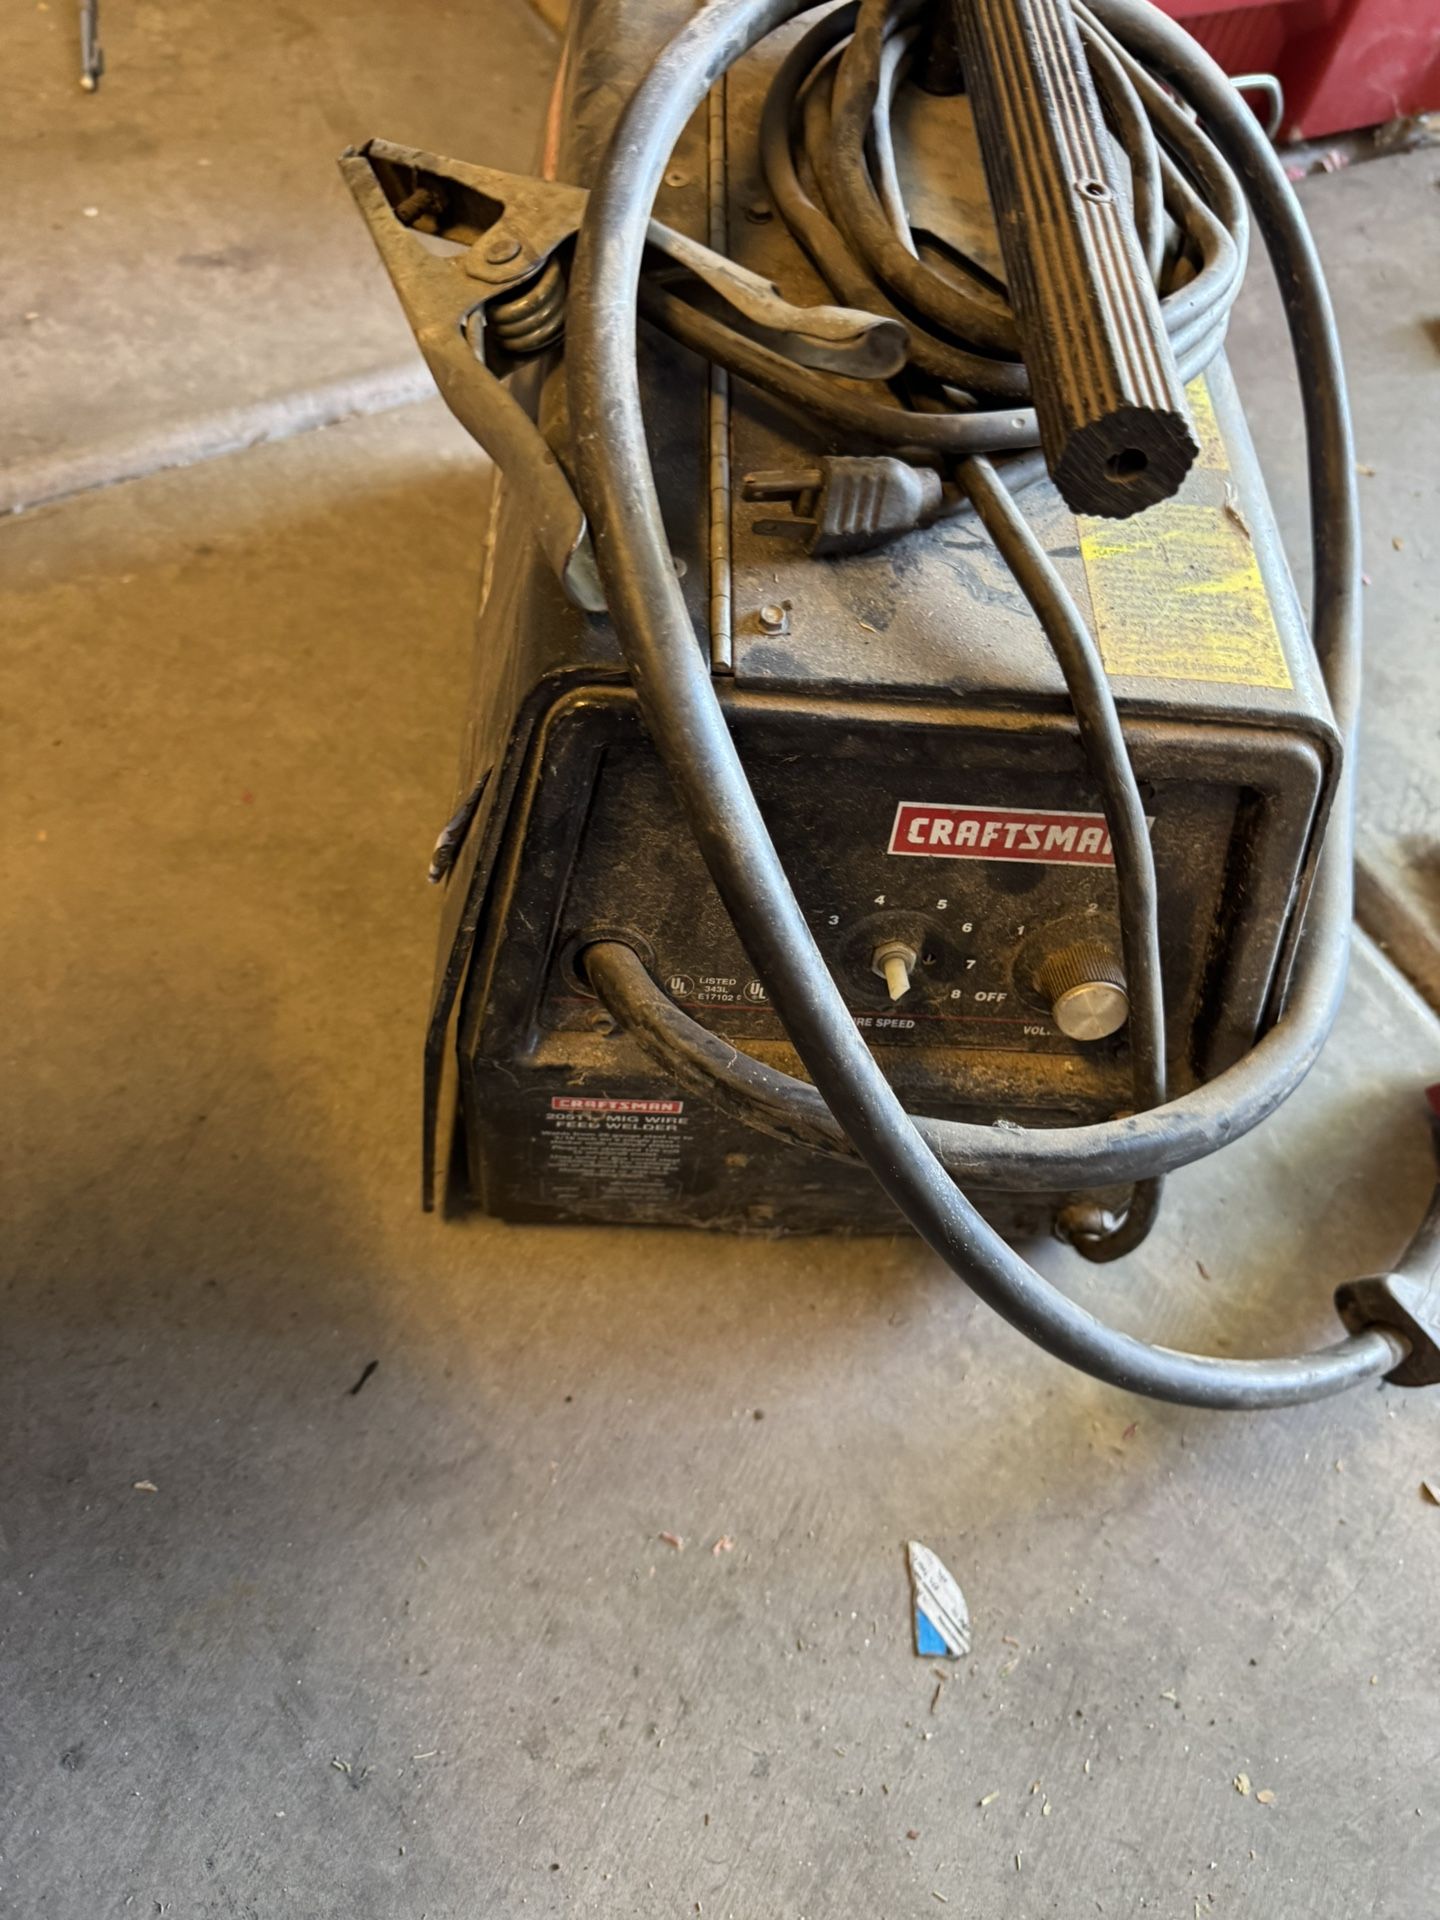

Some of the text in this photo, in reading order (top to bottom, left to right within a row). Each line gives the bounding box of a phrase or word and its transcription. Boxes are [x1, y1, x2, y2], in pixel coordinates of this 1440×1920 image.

[874, 894, 886, 905] 4
[936, 899, 948, 909] 5
[829, 915, 839, 925] 3
[962, 922, 973, 933] 6
[1017, 925, 1025, 936] 1
[965, 960, 976, 970] 7
[699, 977, 737, 985] LISTED
[698, 993, 734, 1001] E17102
[950, 989, 961, 999] 8
[975, 990, 1007, 1003] OFF
[875, 1018, 916, 1029] SPEED
[1023, 1026, 1051, 1036] VOL.
[558, 1098, 673, 1111] CRAFTSMAN
[606, 1115, 640, 1124] MIG
[645, 1116, 689, 1125] WIRE
[555, 1121, 678, 1132] FEED WELDER
